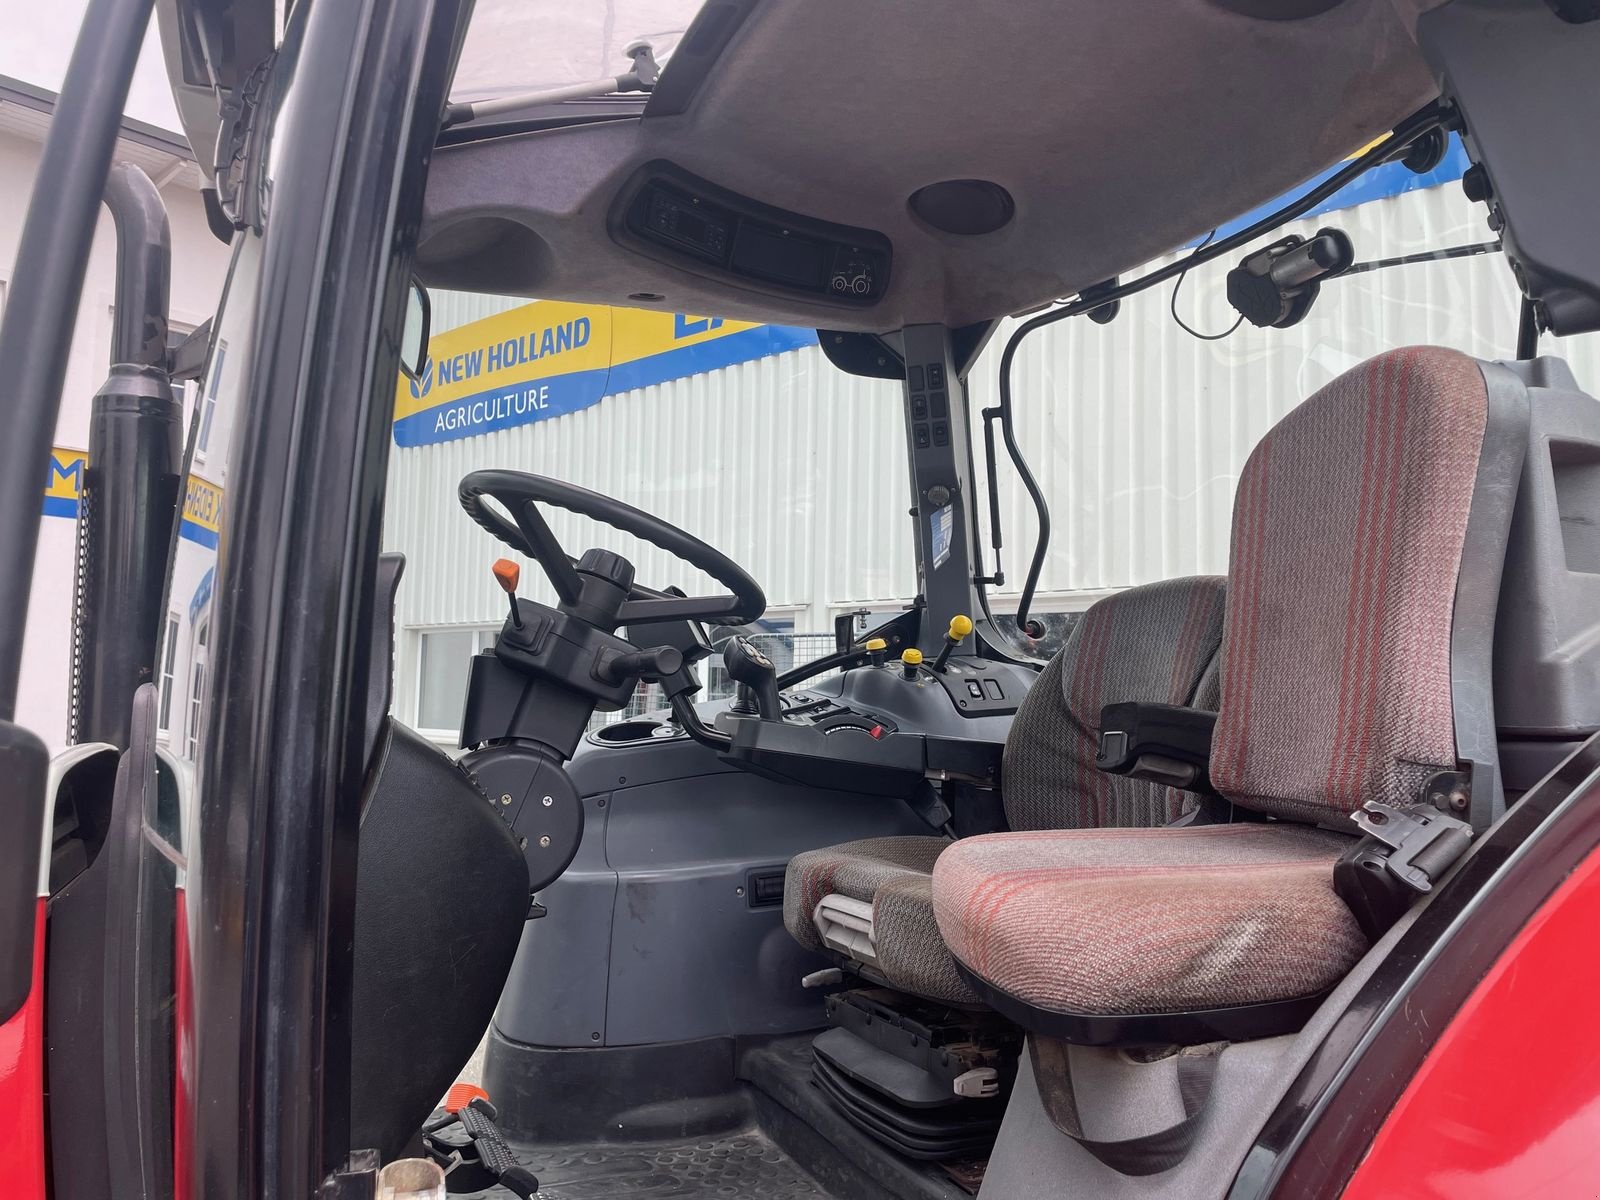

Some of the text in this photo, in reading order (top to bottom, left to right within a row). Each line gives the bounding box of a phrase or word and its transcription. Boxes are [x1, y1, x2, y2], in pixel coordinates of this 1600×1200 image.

[438, 316, 590, 386] NEW HOLLAND
[434, 386, 549, 432] AGRICULTURE
